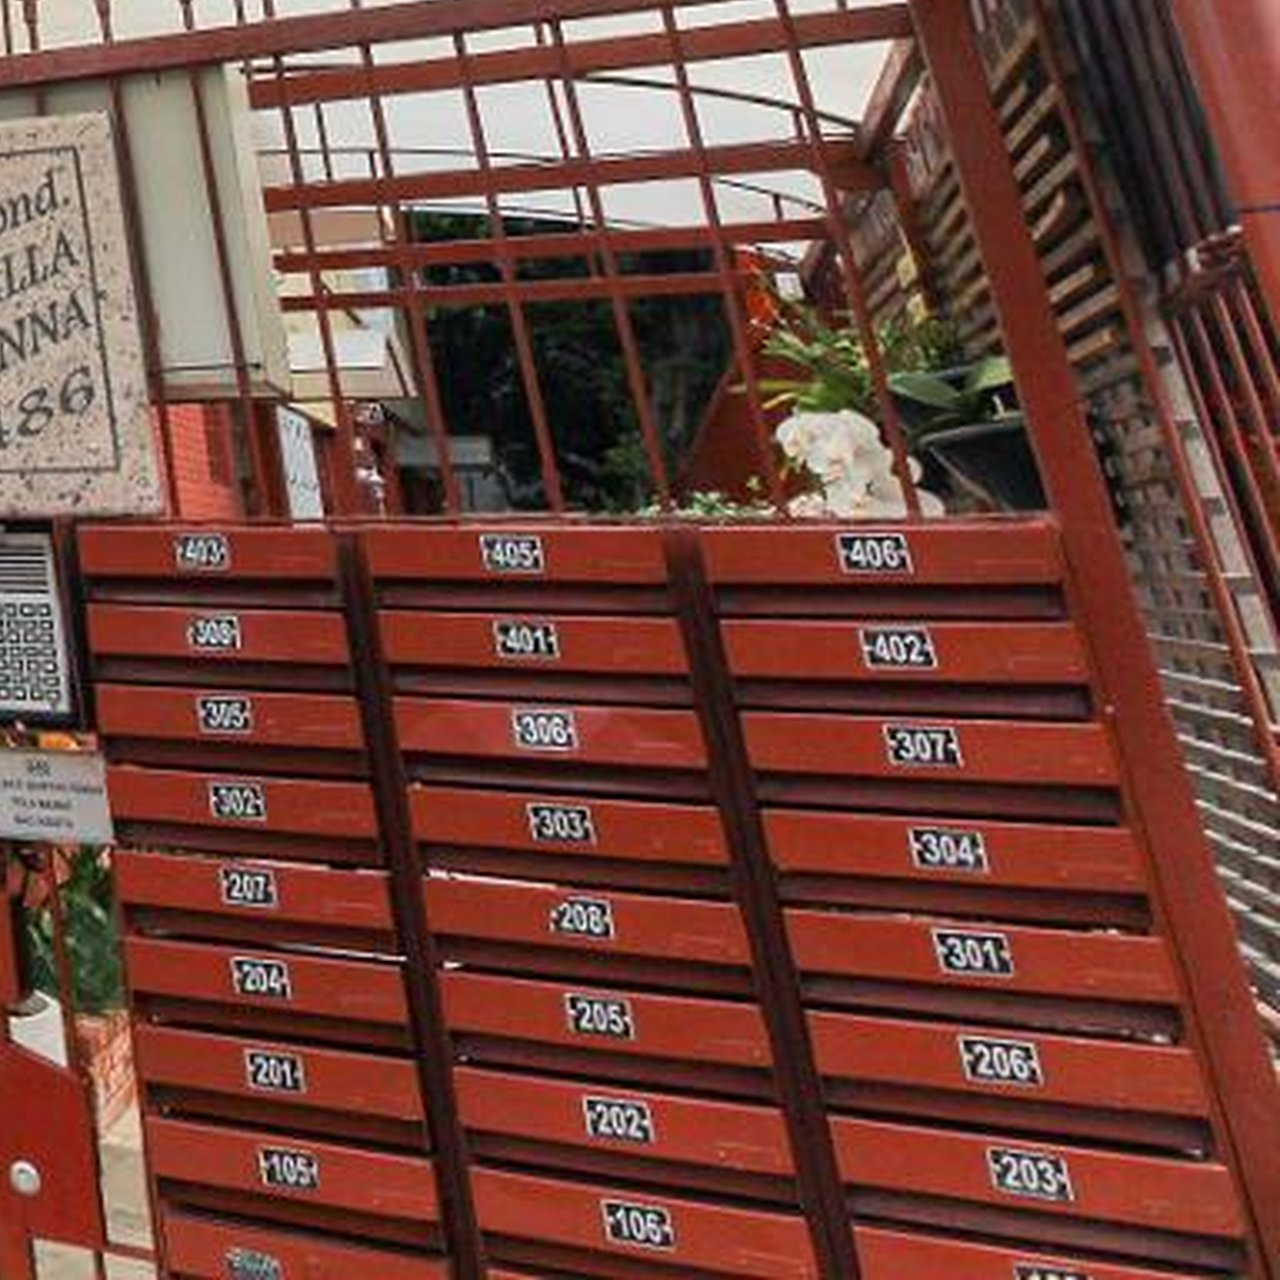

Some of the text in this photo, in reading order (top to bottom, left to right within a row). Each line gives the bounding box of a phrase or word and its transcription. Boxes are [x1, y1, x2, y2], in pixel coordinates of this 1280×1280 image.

[492, 540, 536, 567] 405
[850, 540, 901, 568] 406
[506, 626, 547, 654] 401
[873, 634, 924, 662] 402
[521, 716, 568, 744] 306
[895, 732, 947, 761] 307
[540, 809, 585, 838] 303
[920, 833, 975, 865] 304
[228, 872, 269, 902] 207
[559, 902, 605, 934] 208
[946, 936, 1003, 971] 301
[241, 963, 283, 994] 204
[576, 1000, 625, 1035] 205
[254, 1056, 294, 1088] 201
[973, 1042, 1030, 1079] 206
[594, 1102, 644, 1139] 202
[270, 1154, 312, 1186] 105
[1000, 1155, 1060, 1194] 203
[616, 1208, 664, 1244] 106
